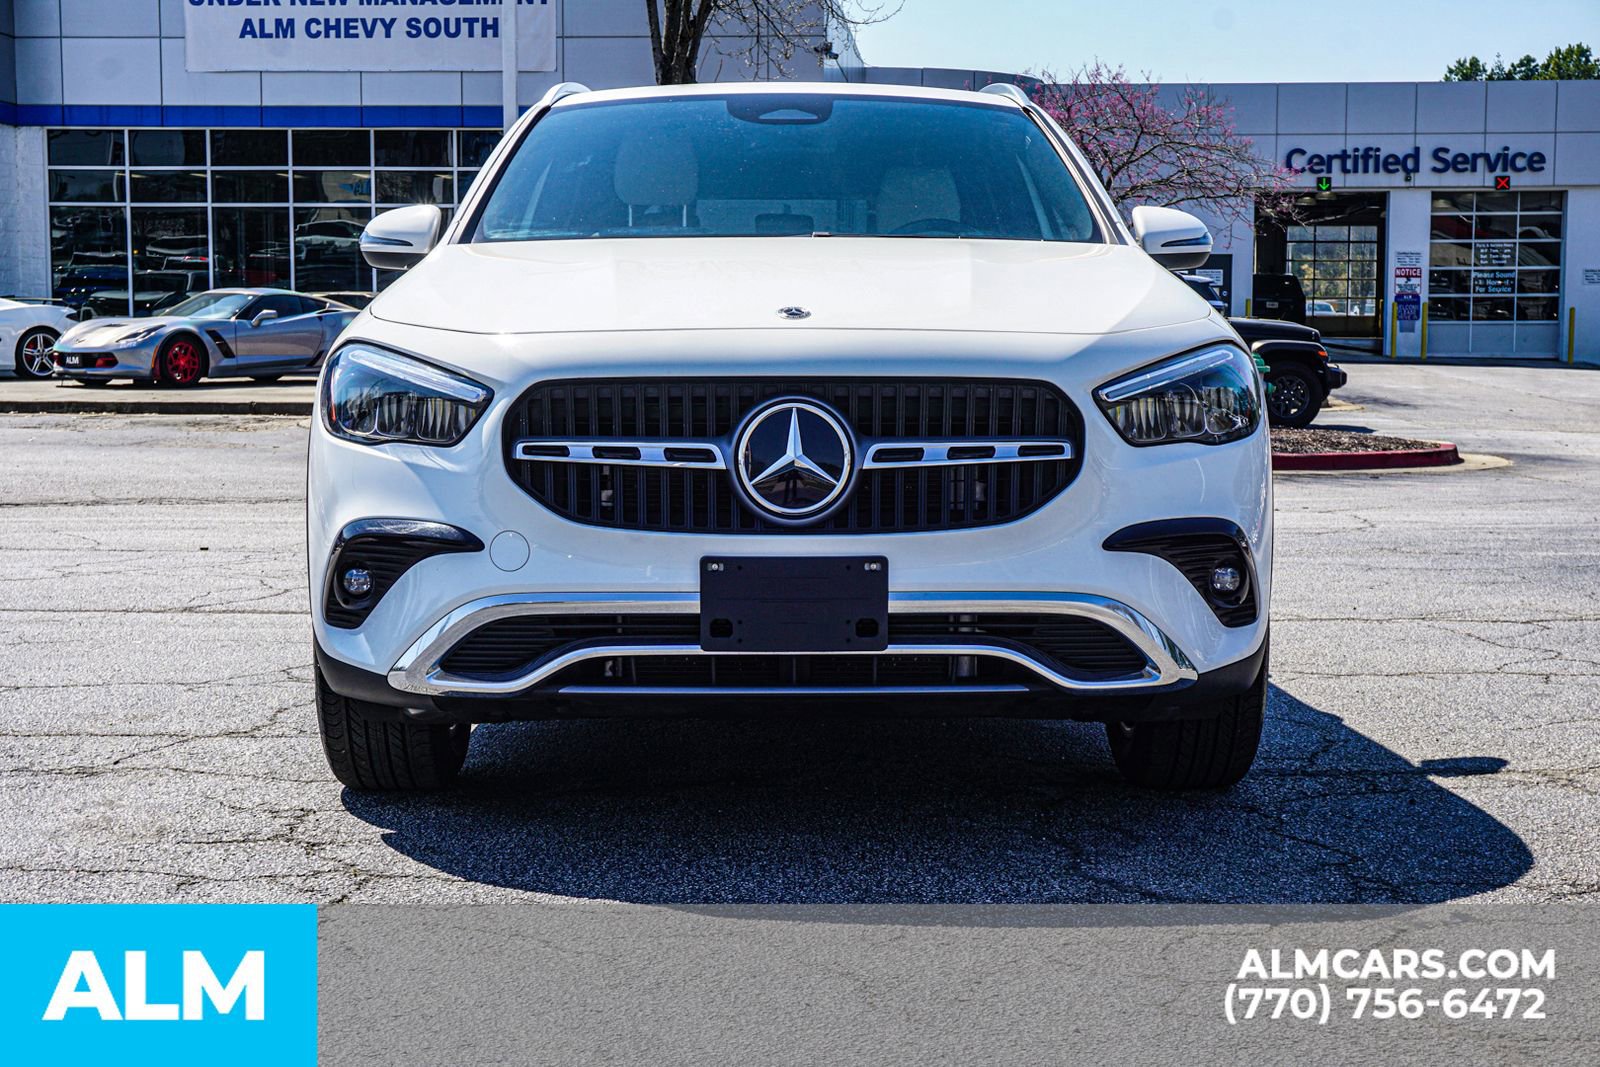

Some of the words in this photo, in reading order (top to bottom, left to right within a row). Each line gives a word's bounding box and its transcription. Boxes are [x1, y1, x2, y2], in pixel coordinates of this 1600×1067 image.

[239, 18, 296, 39] ALM
[304, 18, 397, 39] CHEVY
[405, 17, 499, 39] SOUTH
[1285, 146, 1421, 174] Certified
[1431, 146, 1547, 174] Service
[1396, 268, 1421, 277] NOTICE
[1472, 271, 1495, 279] Please
[1495, 271, 1516, 279] Sound
[65, 356, 80, 365] ALM
